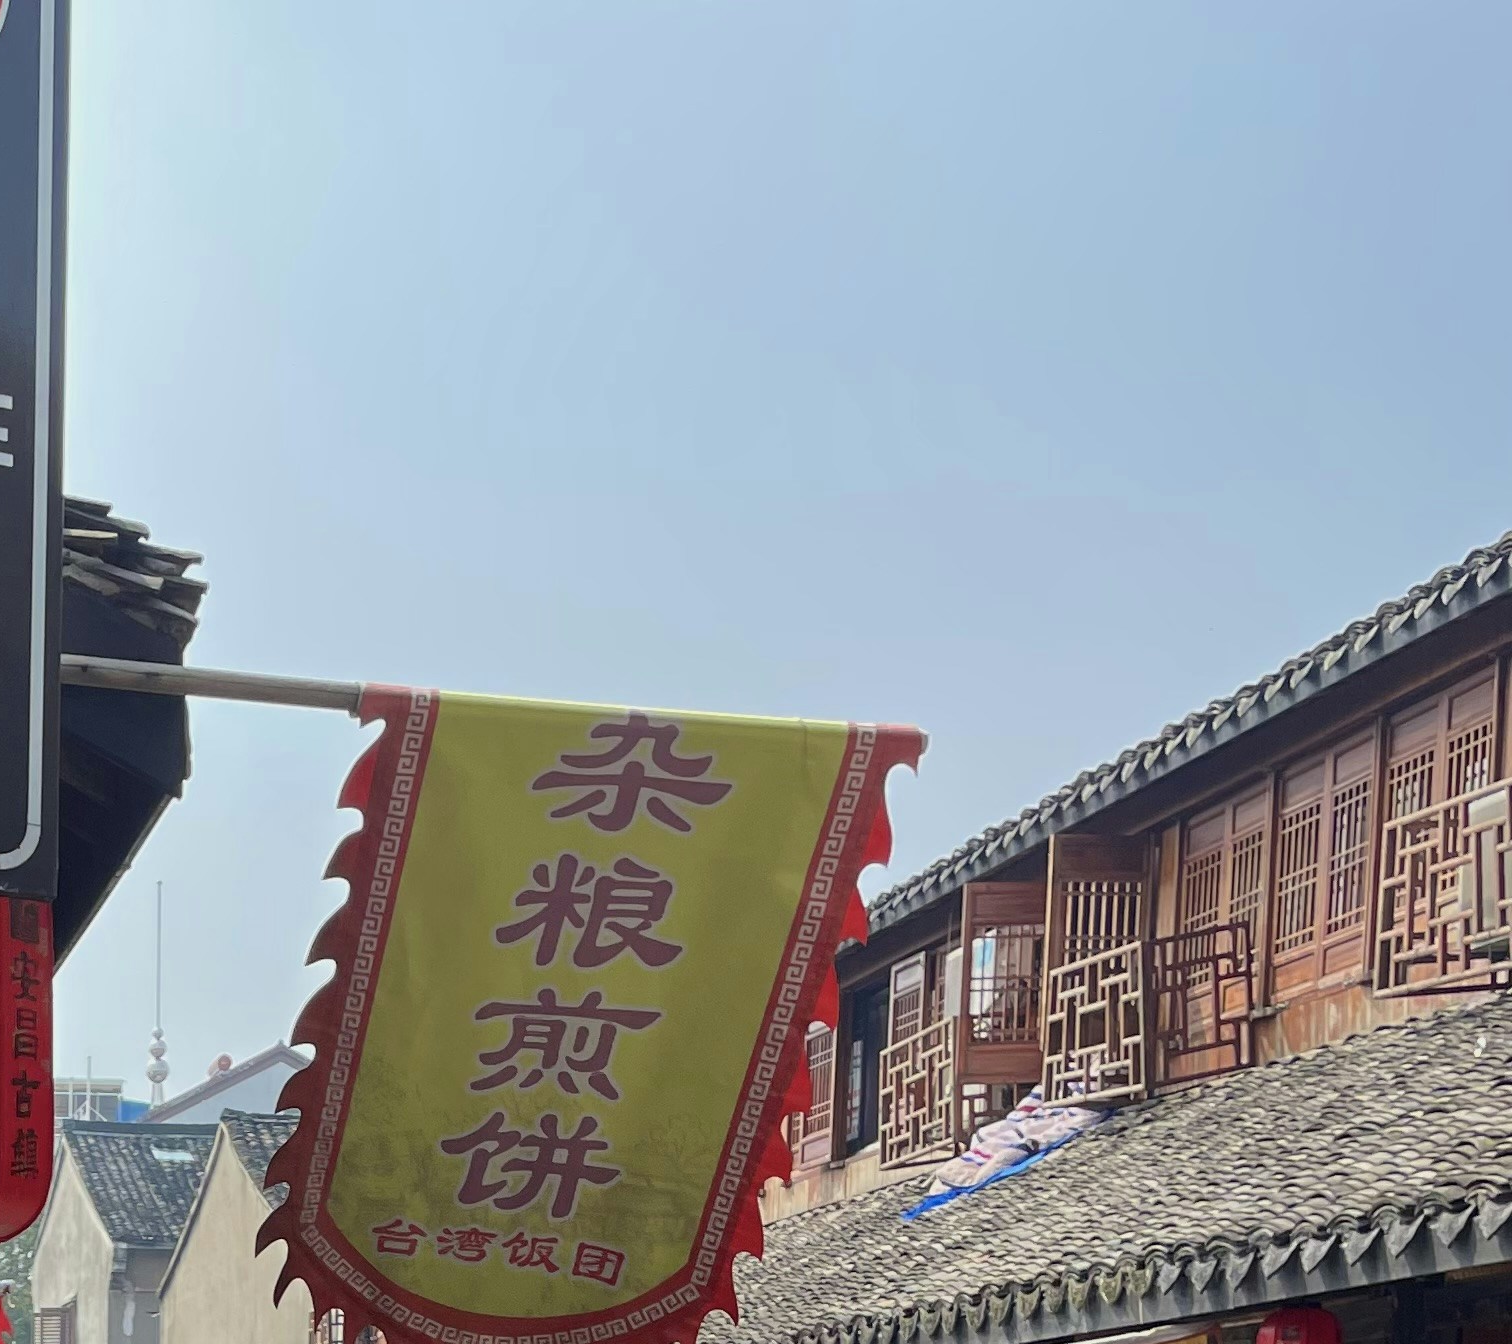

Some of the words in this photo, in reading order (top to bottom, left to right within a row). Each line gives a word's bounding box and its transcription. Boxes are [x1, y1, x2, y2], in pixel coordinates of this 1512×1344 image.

[441, 709, 733, 1220] 杂粮煎饼
[370, 1218, 627, 1288] 台湾饭团
